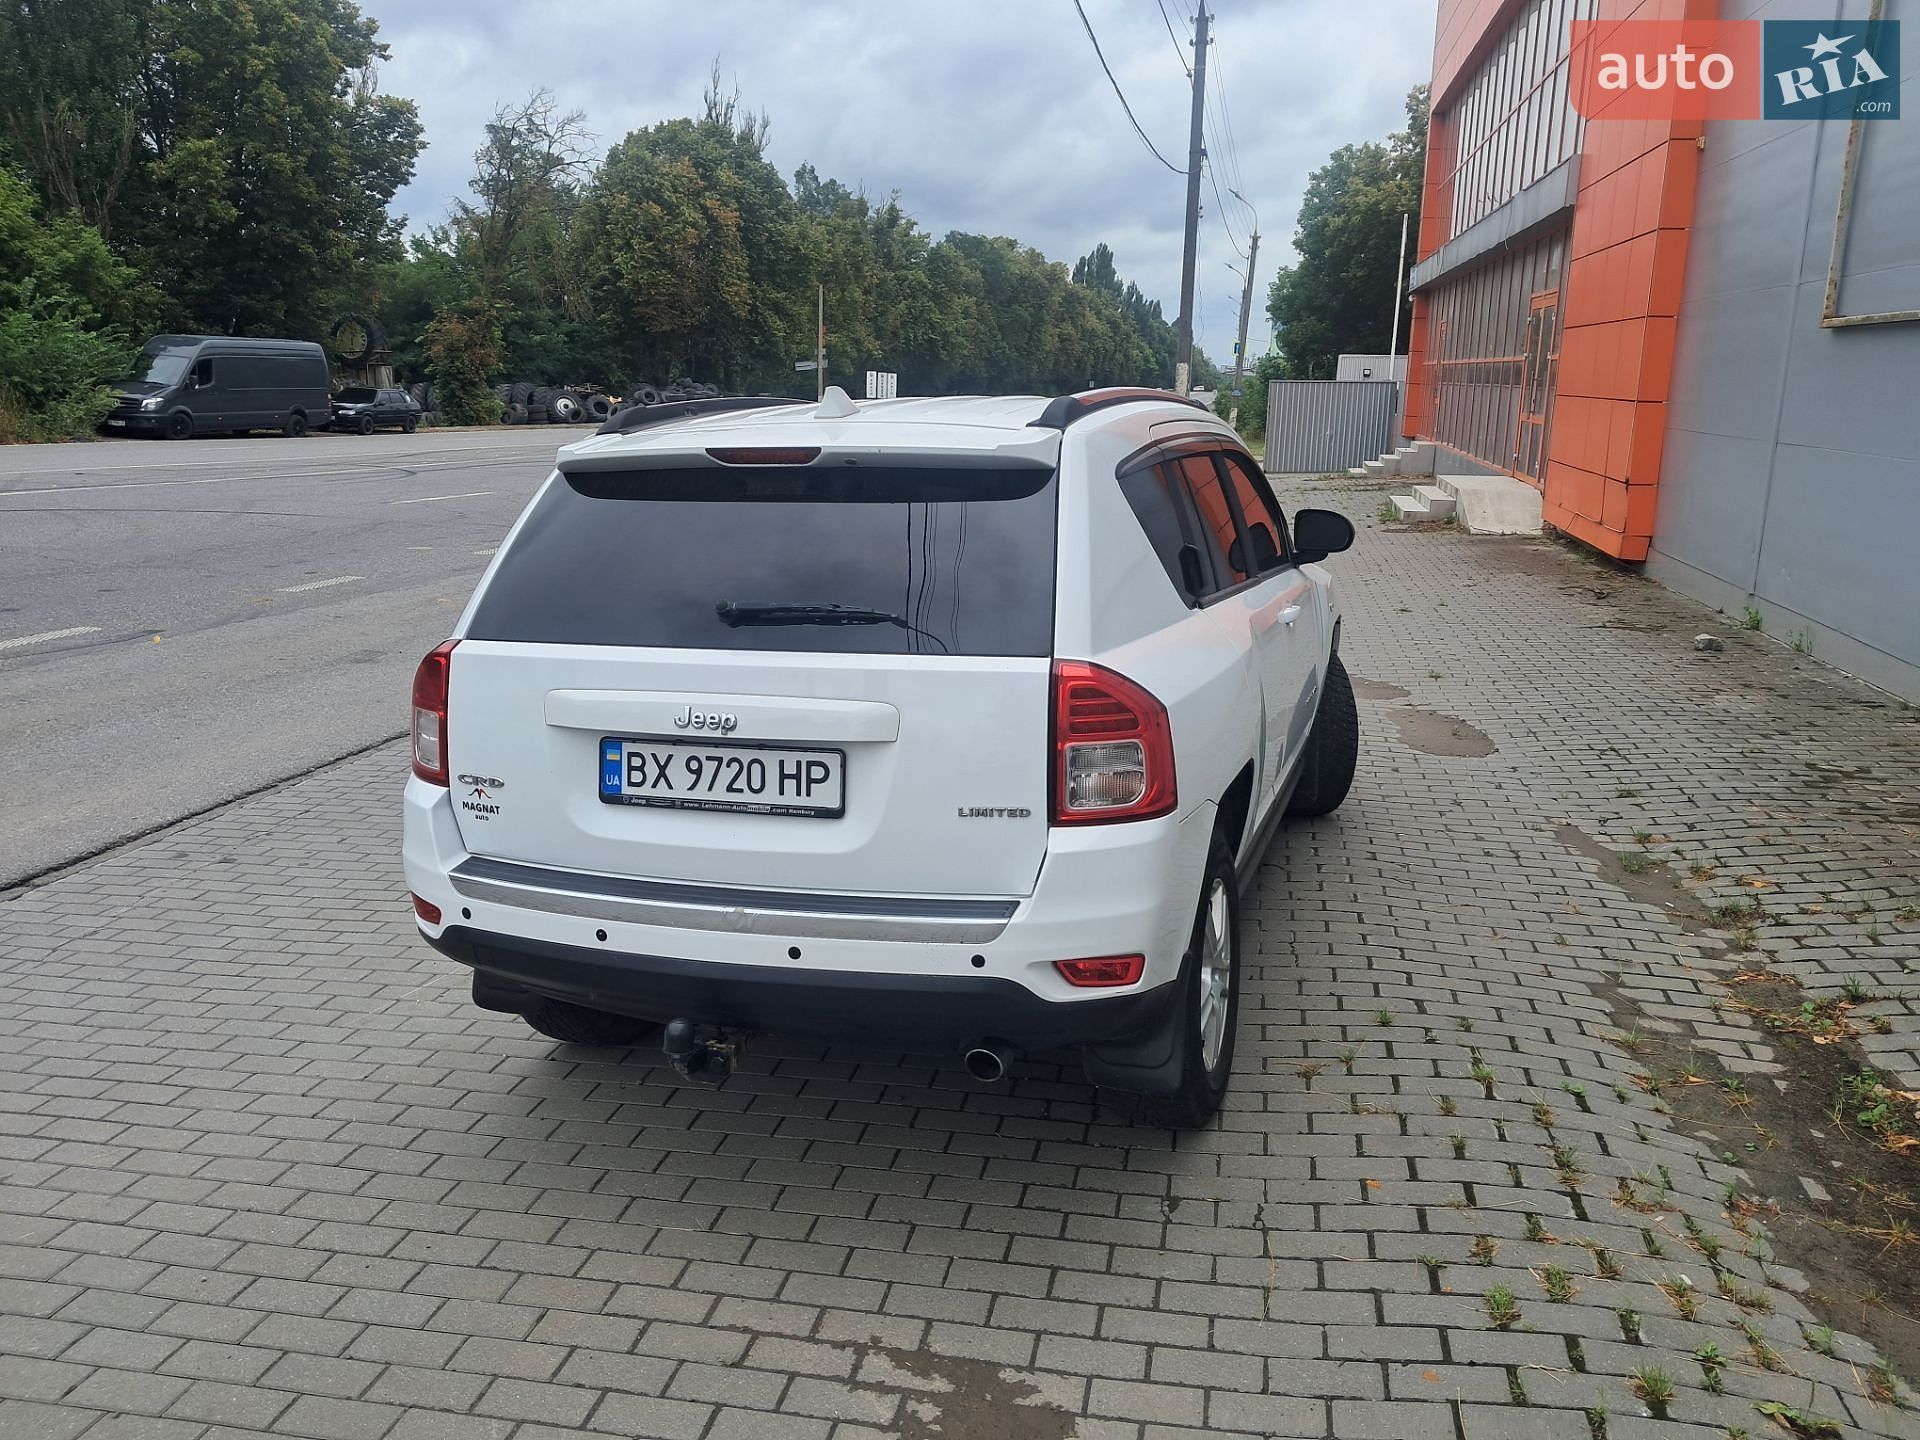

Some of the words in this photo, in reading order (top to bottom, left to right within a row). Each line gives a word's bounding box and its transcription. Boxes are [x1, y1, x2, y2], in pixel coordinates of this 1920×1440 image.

[674, 706, 737, 735] Jeep
[606, 774, 620, 786] UA
[627, 751, 674, 790] BX
[685, 755, 766, 794] 9720
[779, 759, 831, 797] HP
[458, 775, 505, 788] CRD
[462, 801, 500, 814] MAGNAT
[957, 807, 1031, 818] LIMITED
